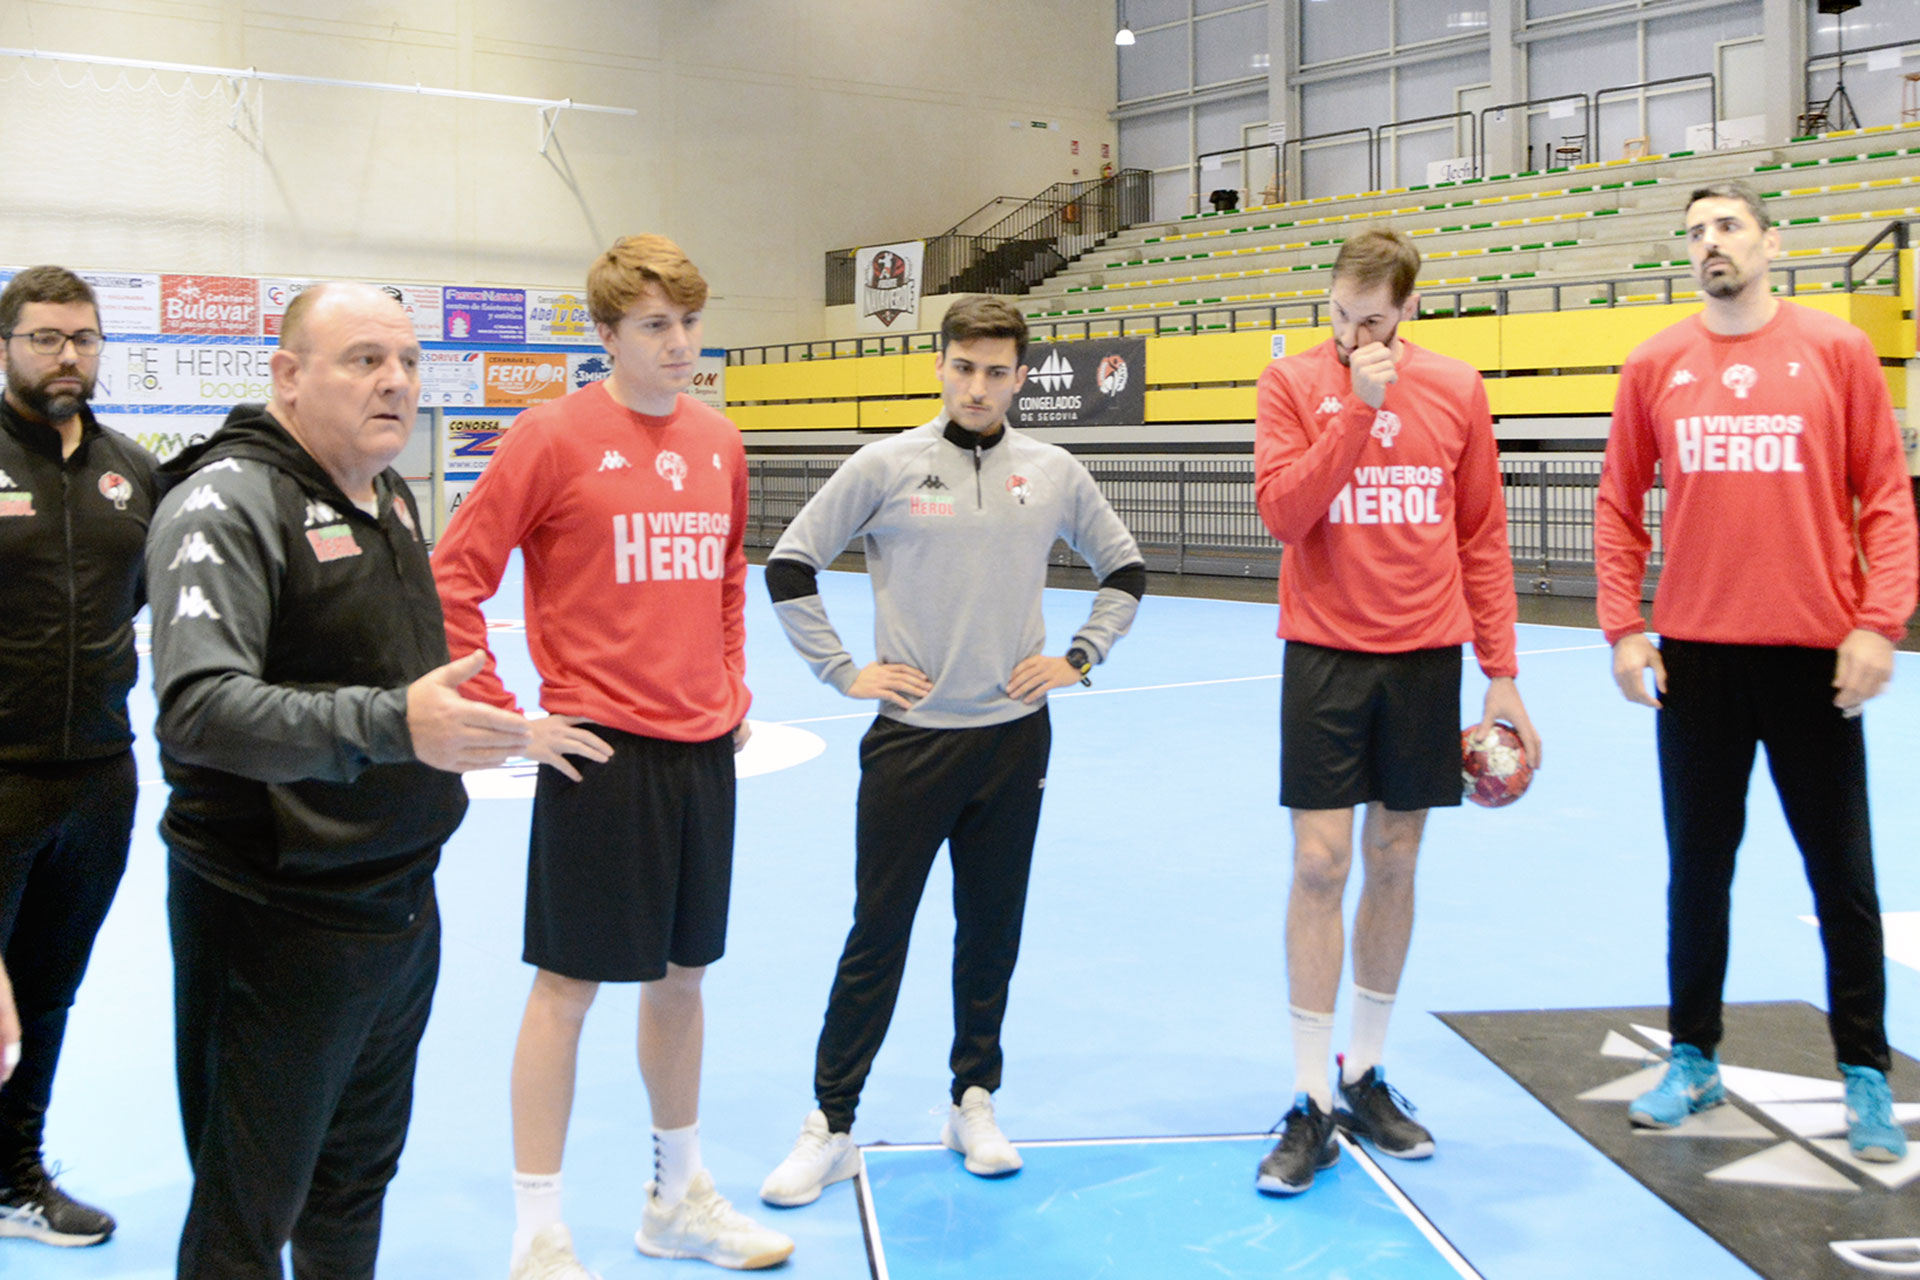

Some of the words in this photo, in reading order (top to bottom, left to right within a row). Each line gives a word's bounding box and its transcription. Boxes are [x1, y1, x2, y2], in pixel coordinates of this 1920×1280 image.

[166, 298, 256, 322] Bulevar
[529, 307, 558, 321] Abel
[560, 309, 569, 323] y
[487, 363, 566, 383] FERTOR
[1787, 361, 1800, 377] 7
[1019, 396, 1082, 411] CONGELADOS
[449, 420, 499, 430] CONORSA
[1021, 412, 1033, 422] DE
[1037, 411, 1079, 422] SEGOVIA
[1703, 415, 1804, 435] VIVEROS
[1675, 416, 1805, 474] HEROL
[1354, 465, 1444, 487] VIVEROS
[910, 495, 955, 517] HEROL
[647, 511, 731, 536] VIVEROS
